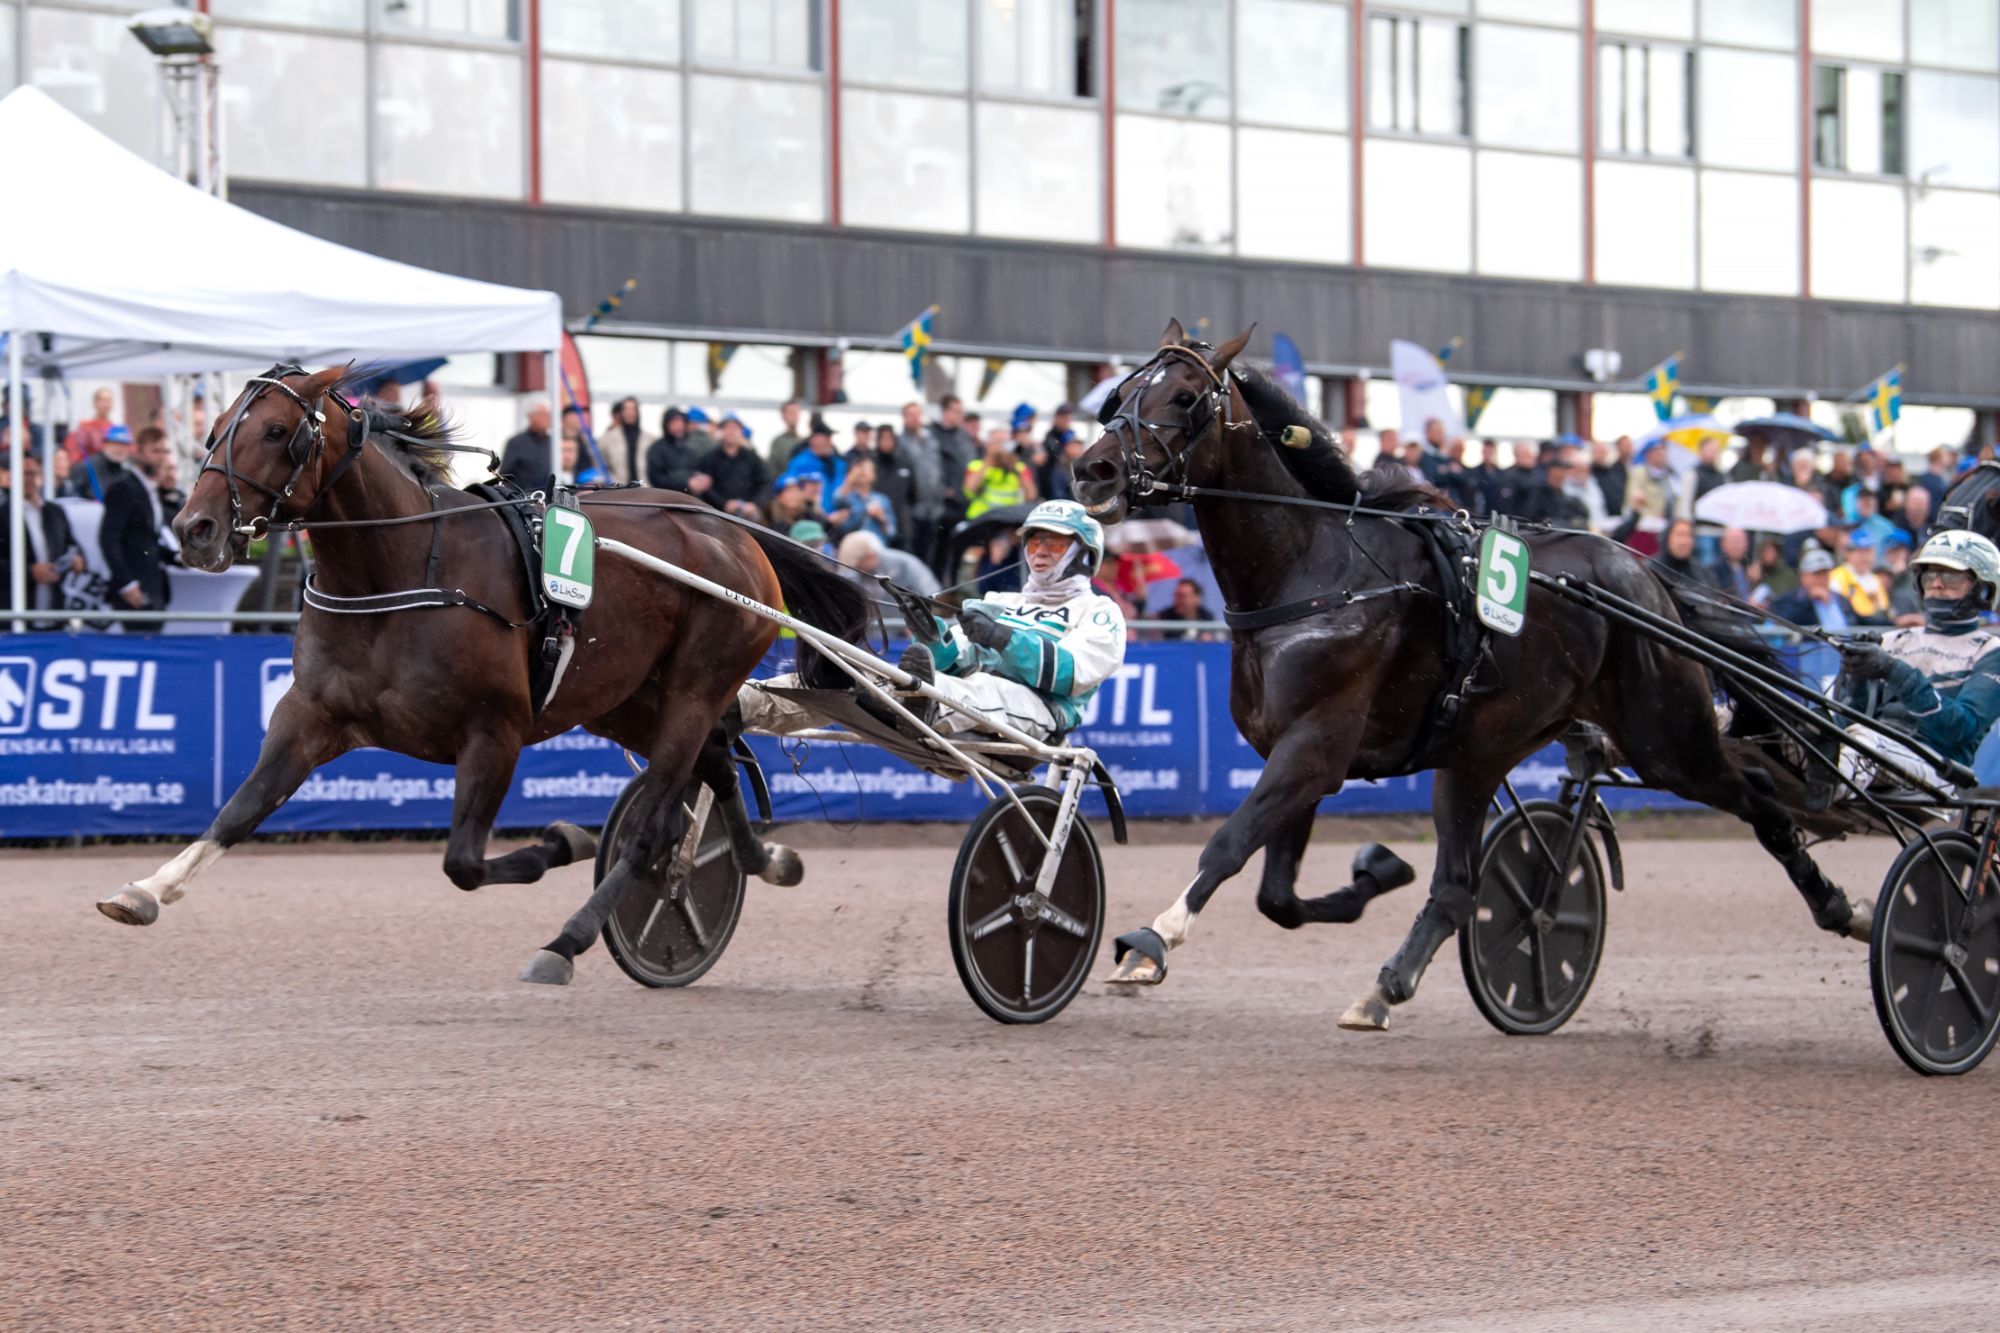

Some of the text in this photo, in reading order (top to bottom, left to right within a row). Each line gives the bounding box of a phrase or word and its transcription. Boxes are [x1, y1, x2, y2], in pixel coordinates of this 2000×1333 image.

[556, 510, 585, 577] 7
[1487, 533, 1521, 605] 5
[725, 587, 752, 606] UFO
[37, 658, 177, 731] STL
[0, 737, 176, 756] ENSKA TRAVLIGAN
[0, 775, 185, 812] nskatravligan.se
[521, 769, 633, 799] svenskatra
